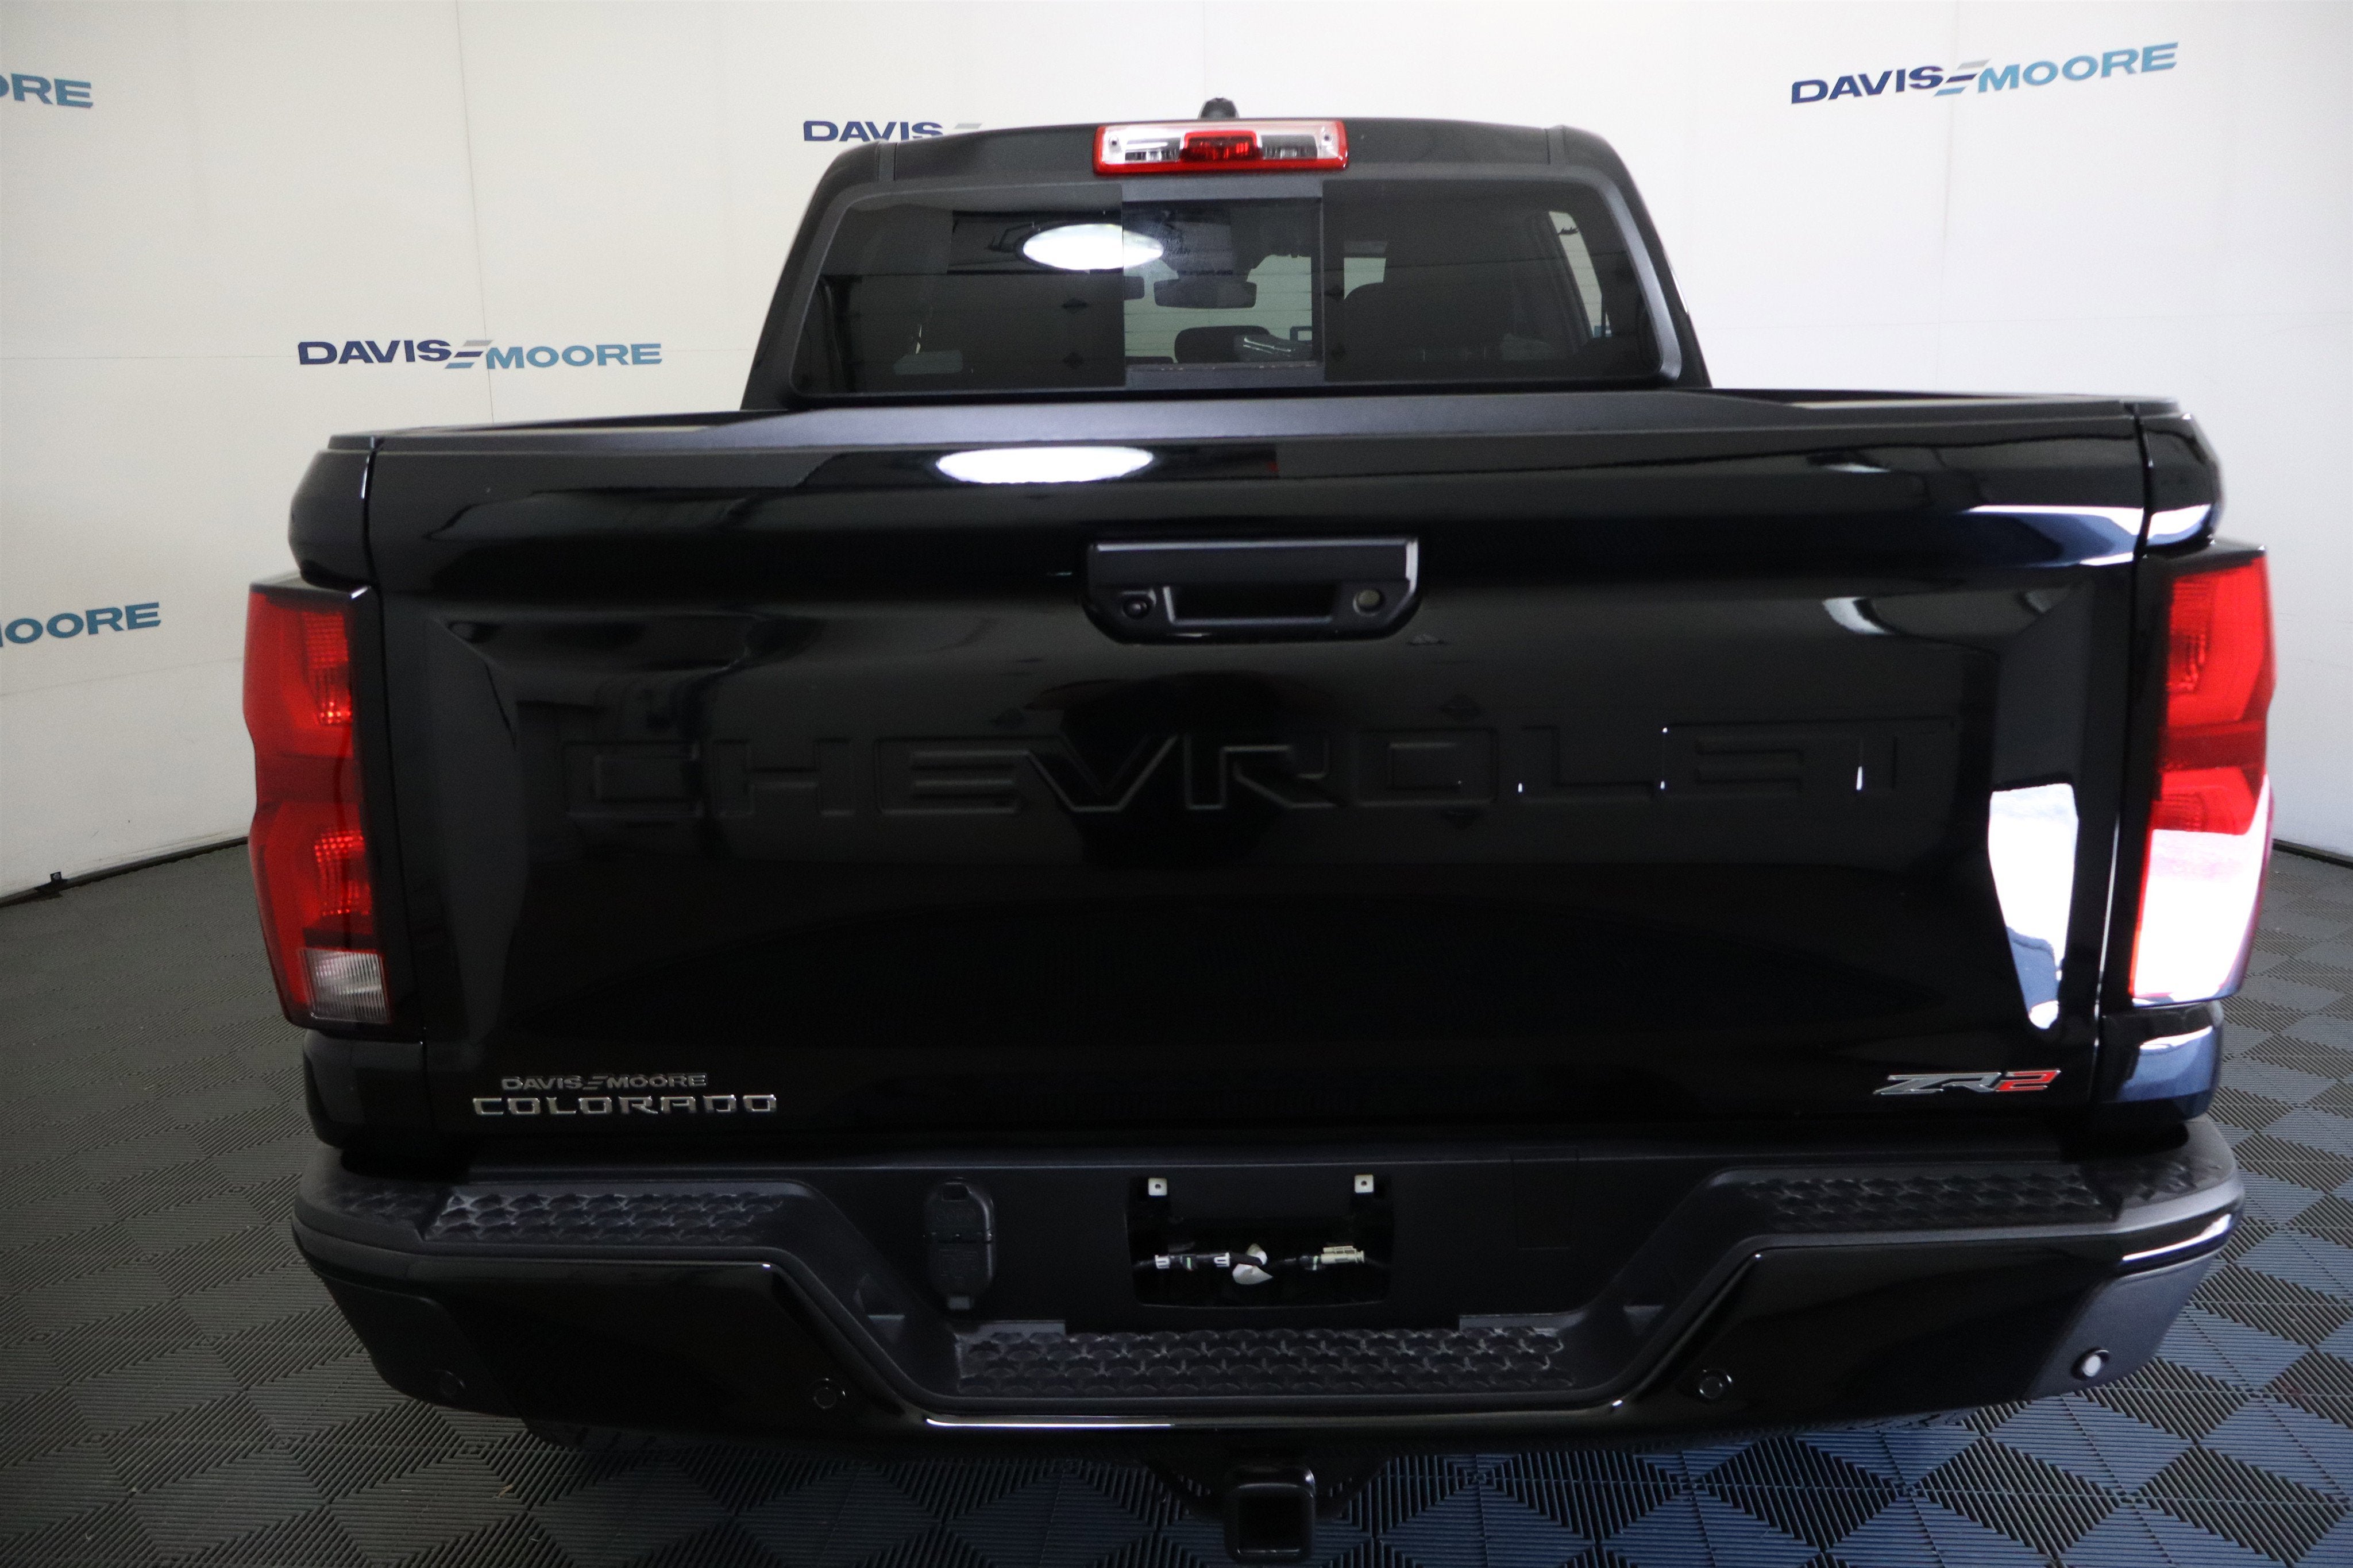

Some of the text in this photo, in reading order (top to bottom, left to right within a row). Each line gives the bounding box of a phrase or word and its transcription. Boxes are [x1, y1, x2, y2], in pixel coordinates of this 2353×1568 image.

[1791, 42, 2178, 105] DAVIS MOORE
[0, 72, 93, 109] RE
[803, 120, 943, 142] DAVIS
[298, 339, 663, 369] DAVIS MOORE
[0, 602, 161, 647] OORE
[562, 716, 1953, 817] CHEVROLET
[502, 1072, 708, 1090] DAVIS MOORE
[1873, 1068, 2061, 1095] ZR2
[473, 1094, 777, 1115] COLORADO
